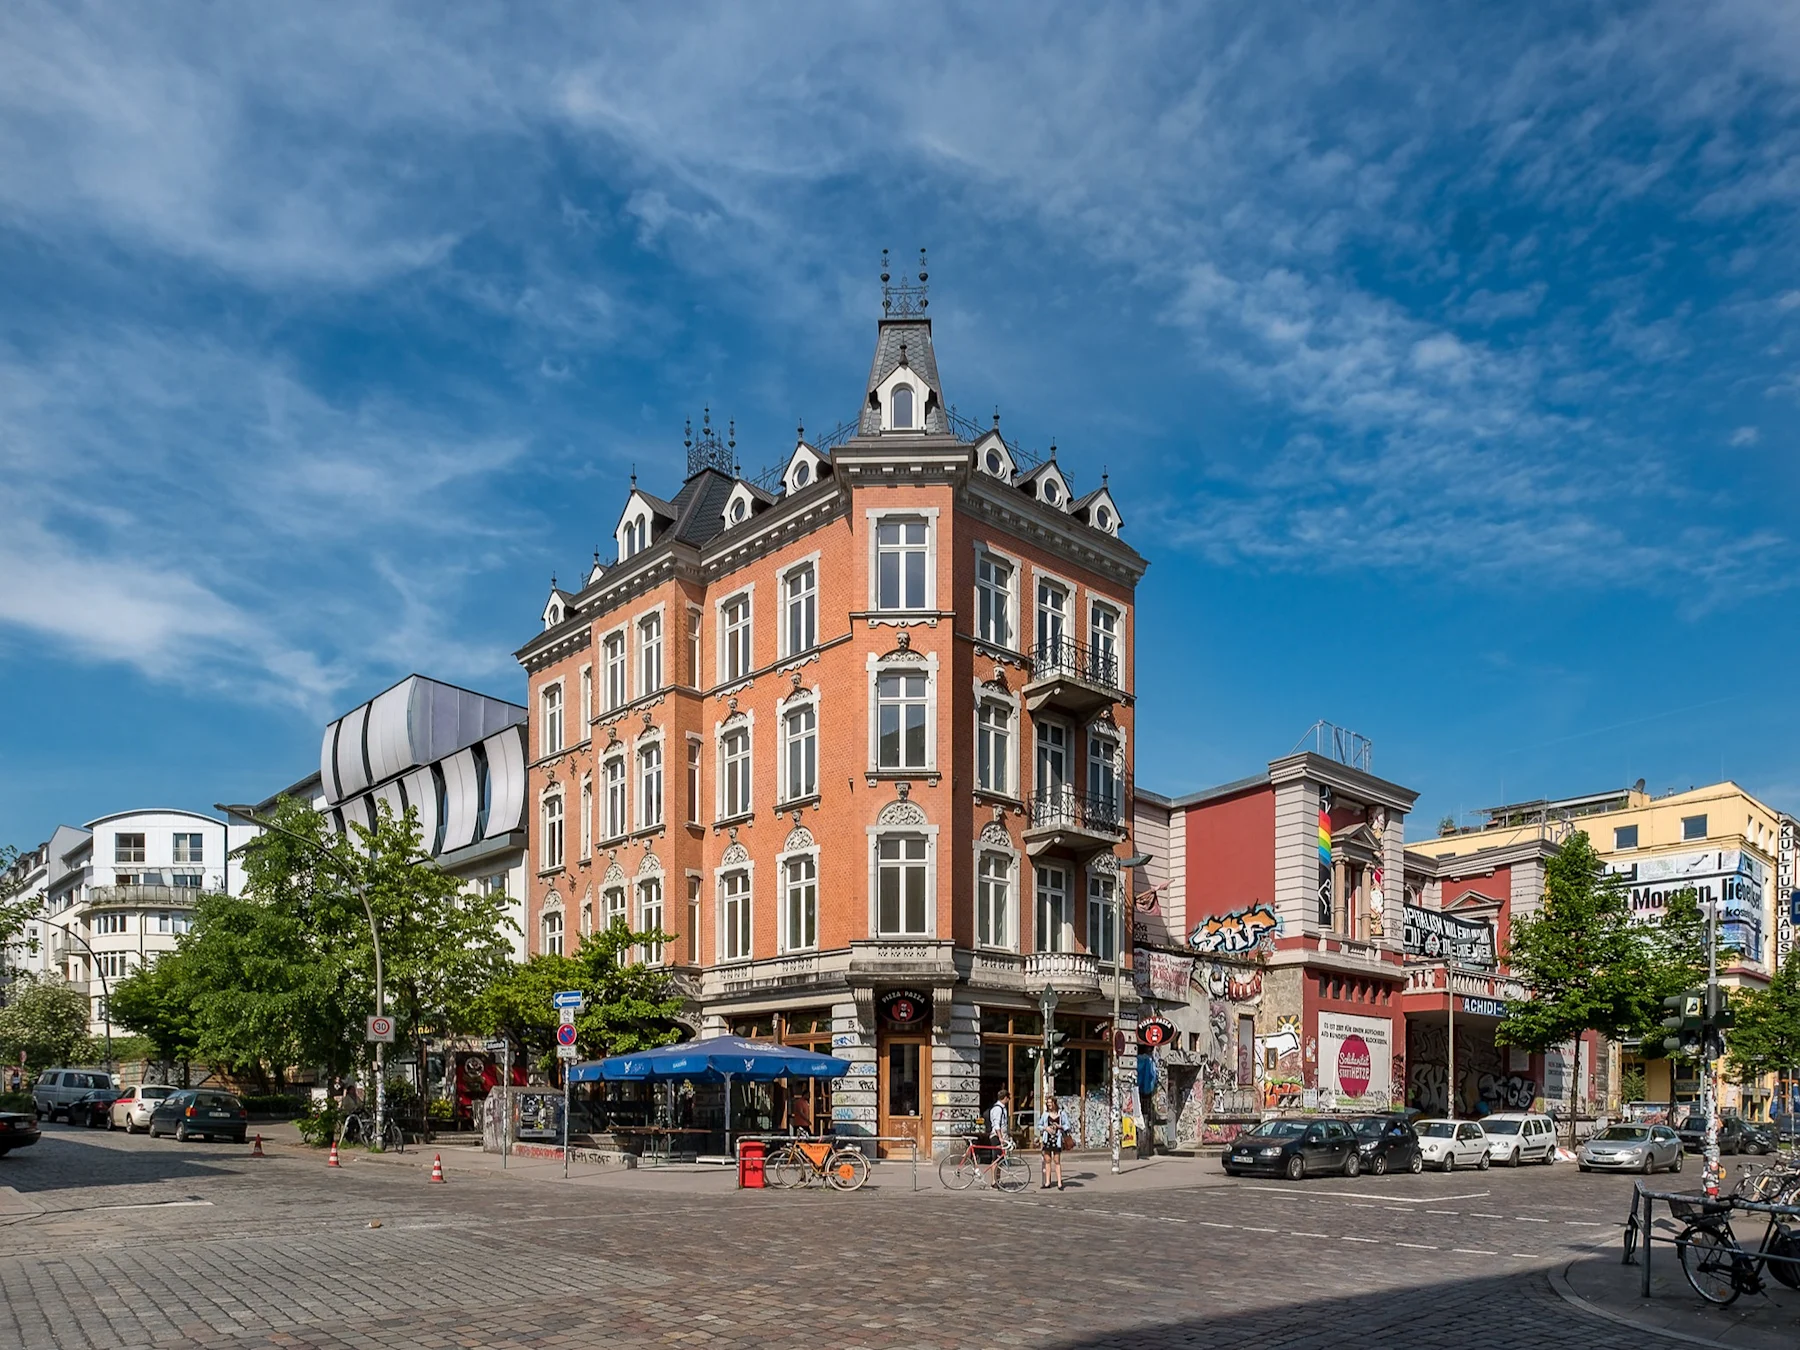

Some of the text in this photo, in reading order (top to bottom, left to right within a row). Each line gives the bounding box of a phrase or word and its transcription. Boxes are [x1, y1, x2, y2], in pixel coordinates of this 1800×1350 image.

[1780, 827, 1791, 953] KULTURHAUS
[1403, 907, 1443, 935] APITALISM
[1403, 925, 1421, 947] OU
[881, 991, 925, 1004] PIZZA PAZZA
[376, 1022, 386, 1031] 30
[1138, 1018, 1172, 1029] PIZZA PAZZA
